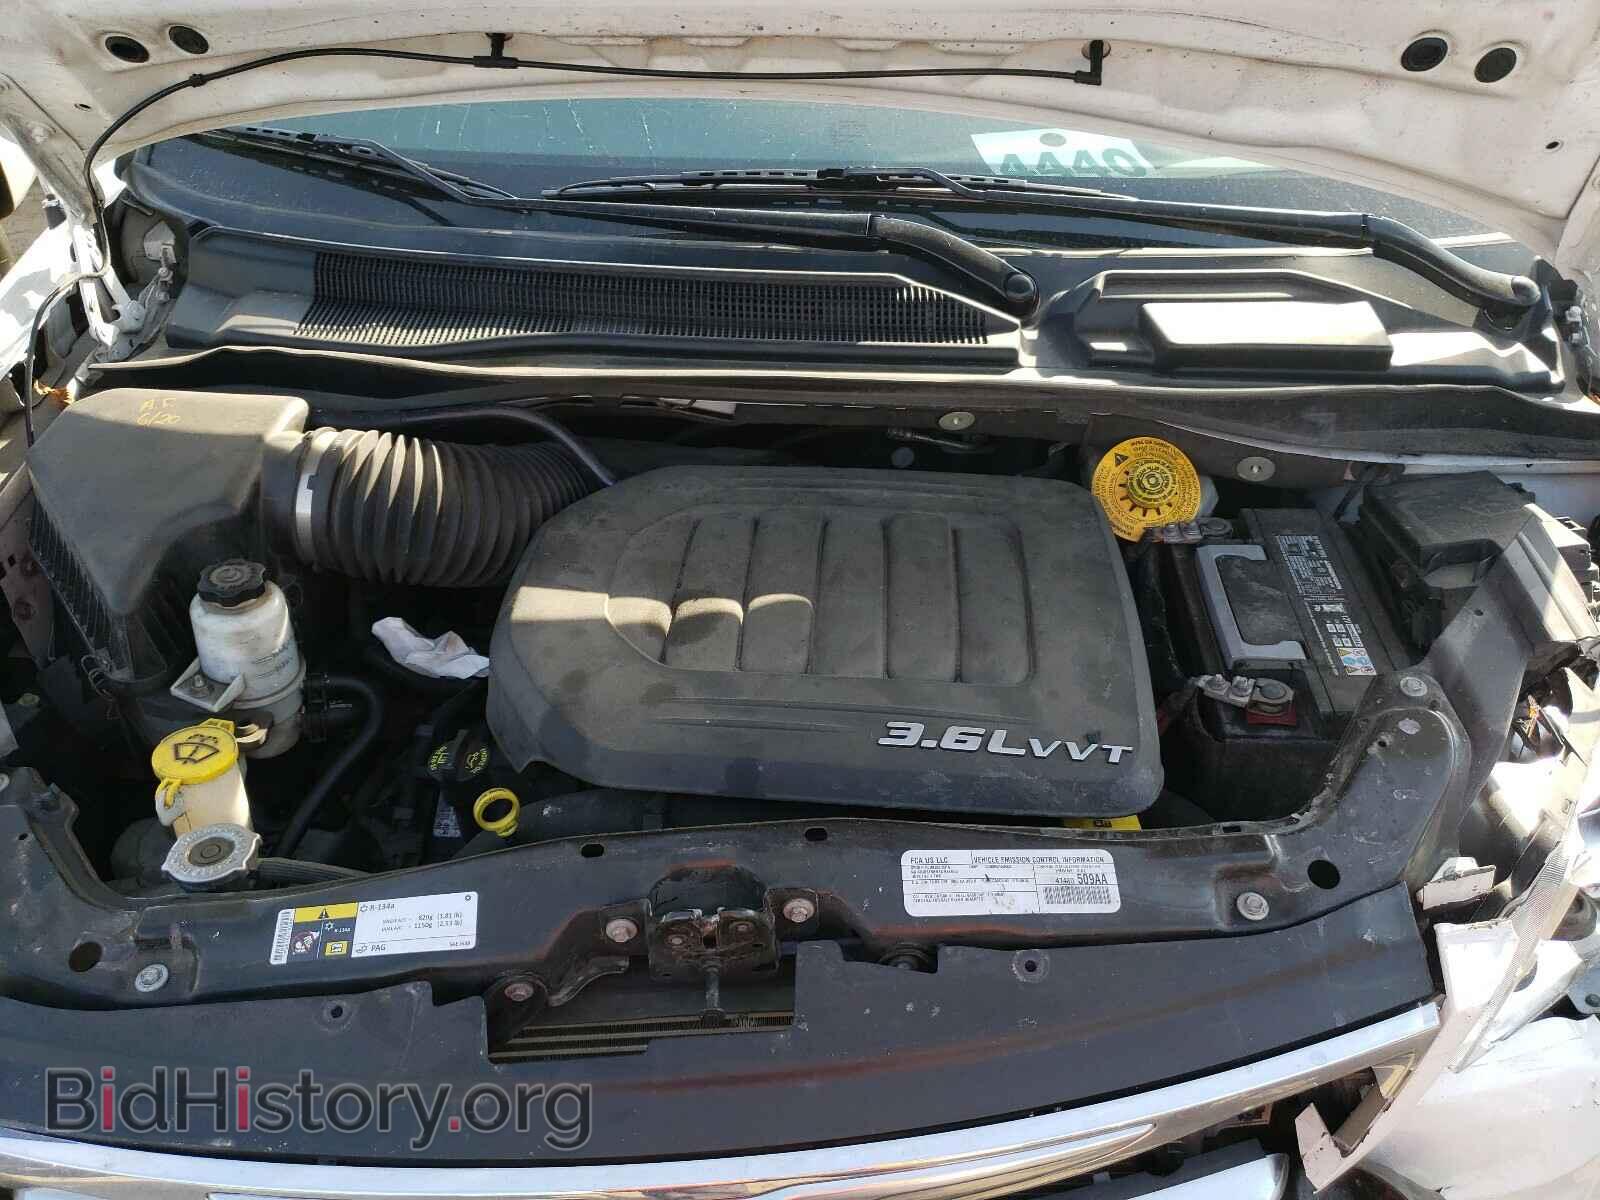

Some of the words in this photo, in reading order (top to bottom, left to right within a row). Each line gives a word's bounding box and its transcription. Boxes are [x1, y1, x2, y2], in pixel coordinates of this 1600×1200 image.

[877, 721, 1027, 757] 3.6L
[1029, 738, 1134, 764] VVT
[973, 856, 999, 864] VEHICLE
[1000, 856, 1031, 864] EMISSION
[1032, 856, 1060, 864] CONTROL
[1062, 856, 1105, 864] INFORMATION
[1077, 873, 1109, 885] 509AA
[371, 944, 386, 952] PAG
